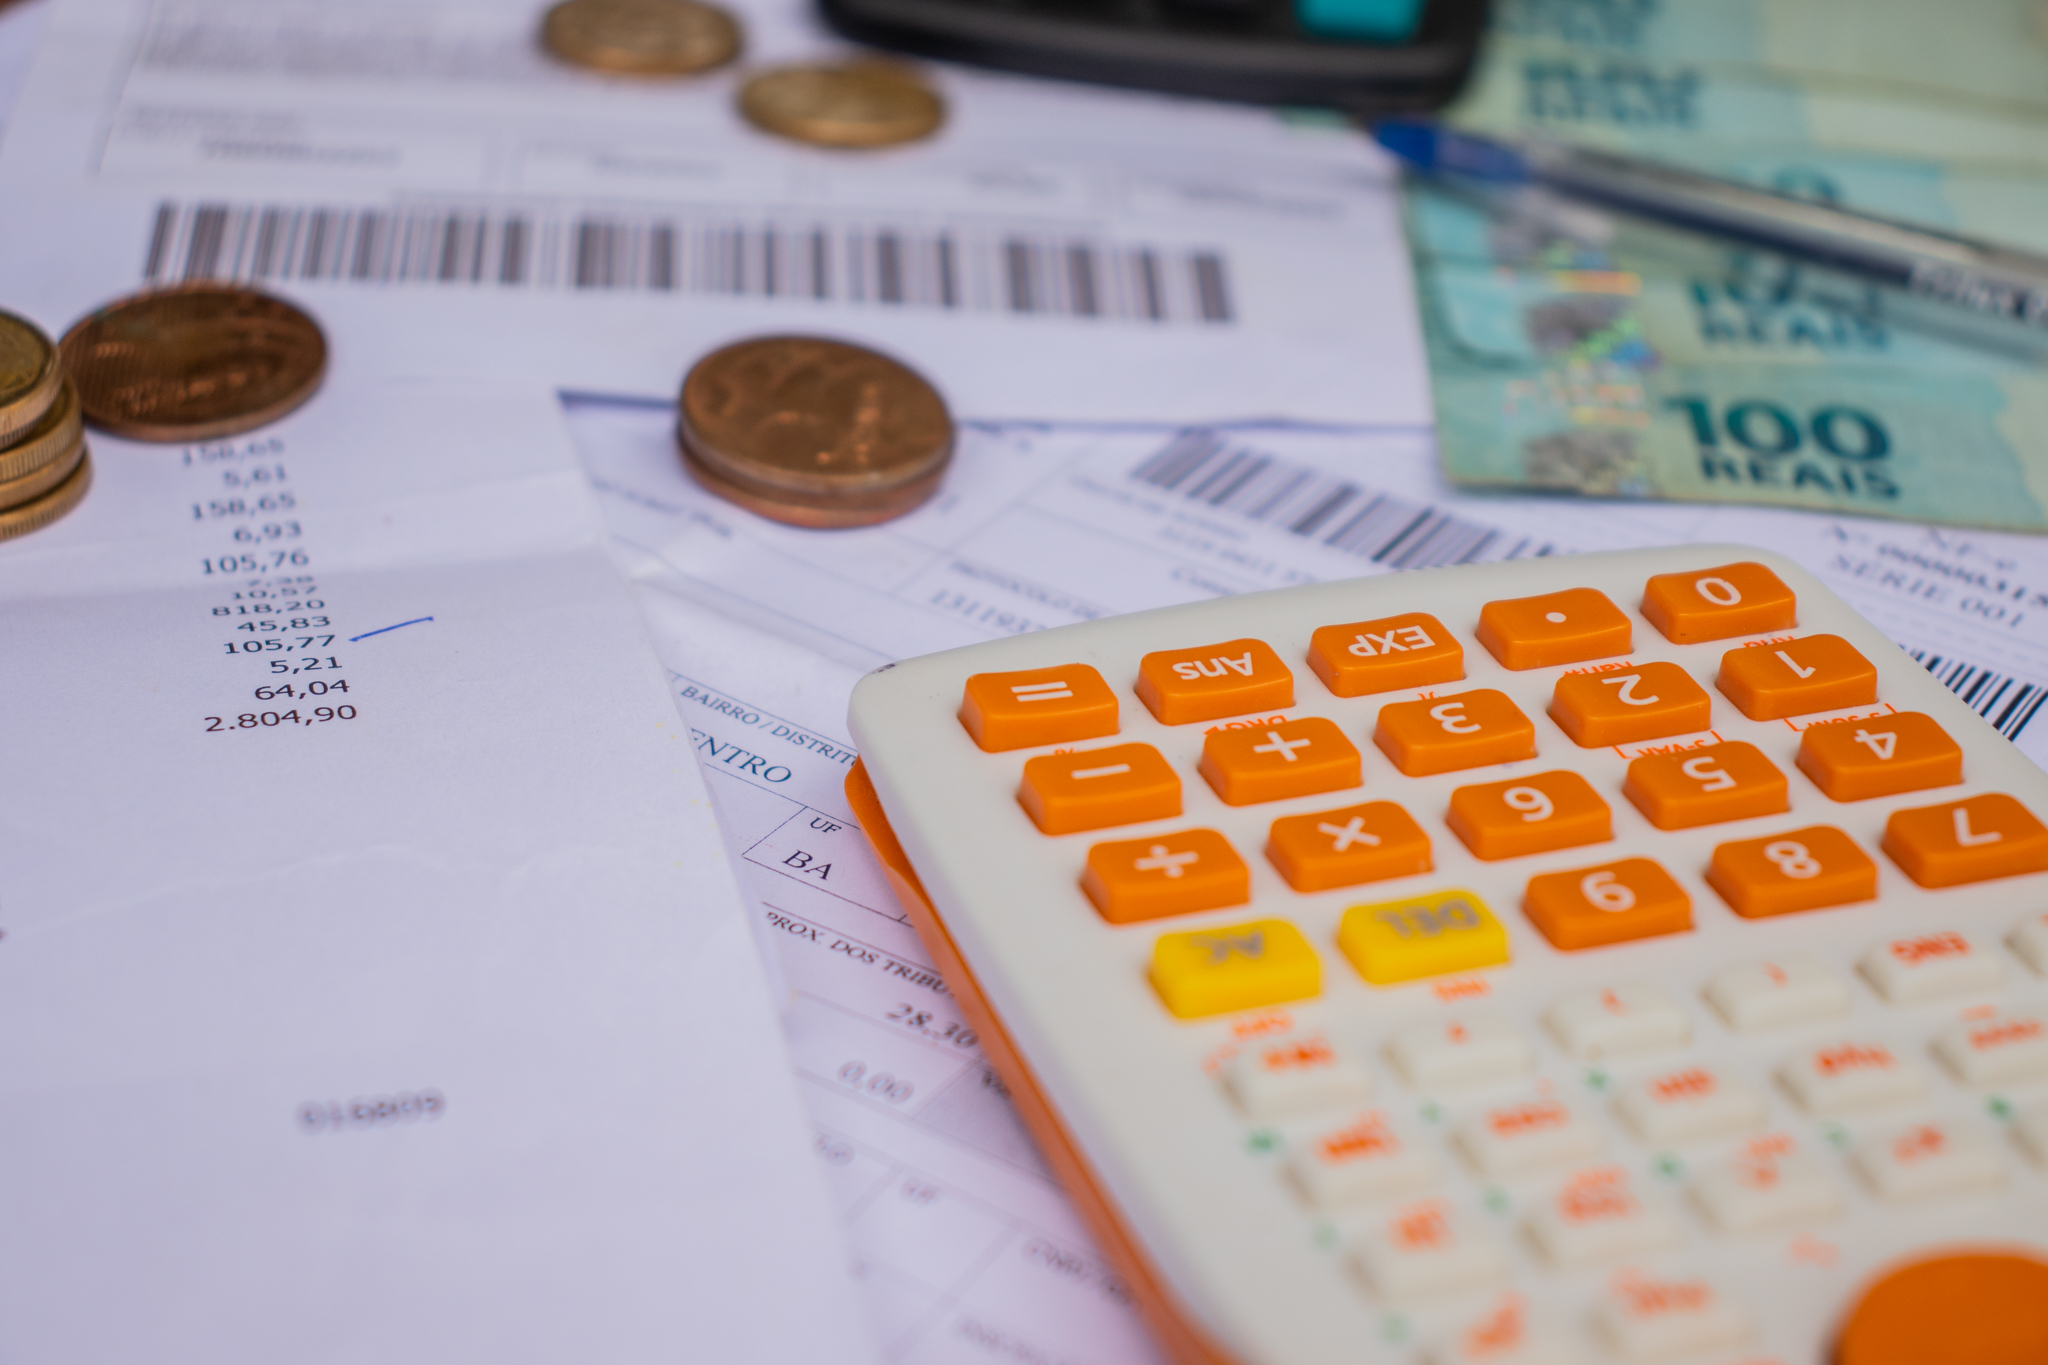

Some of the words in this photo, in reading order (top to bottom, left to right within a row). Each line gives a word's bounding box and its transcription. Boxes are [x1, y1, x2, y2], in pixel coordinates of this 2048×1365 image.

[1662, 393, 1891, 463] 100
[1701, 459, 1901, 499] REAIS
[232, 519, 302, 546] 6,93
[201, 546, 310, 576] 105,76
[211, 599, 326, 617] 818,20
[1695, 577, 1742, 606] 0
[237, 616, 331, 633] 45,83
[1959, 596, 2025, 629] 001
[223, 634, 336, 655] 105,77
[1347, 624, 1437, 658] EXP
[270, 656, 343, 675] 5,21
[1172, 651, 1255, 681] Ans
[1774, 650, 1816, 679] 1
[254, 678, 351, 701] 64,04
[680, 685, 760, 725] BAIRRO
[1600, 673, 1661, 707] 2
[203, 703, 358, 733] 2.804,90
[1429, 701, 1483, 735] 3
[1853, 728, 1898, 761] 4
[1681, 756, 1738, 793] 5
[1502, 785, 1555, 823] 6
[809, 816, 842, 836] UF
[1952, 807, 2004, 847] 7
[782, 848, 834, 881] BA
[1763, 840, 1823, 880] 8
[1580, 871, 1637, 913] 9
[1374, 898, 1483, 940] DEL
[829, 938, 880, 965] DOS
[882, 957, 956, 1000] TRIBU
